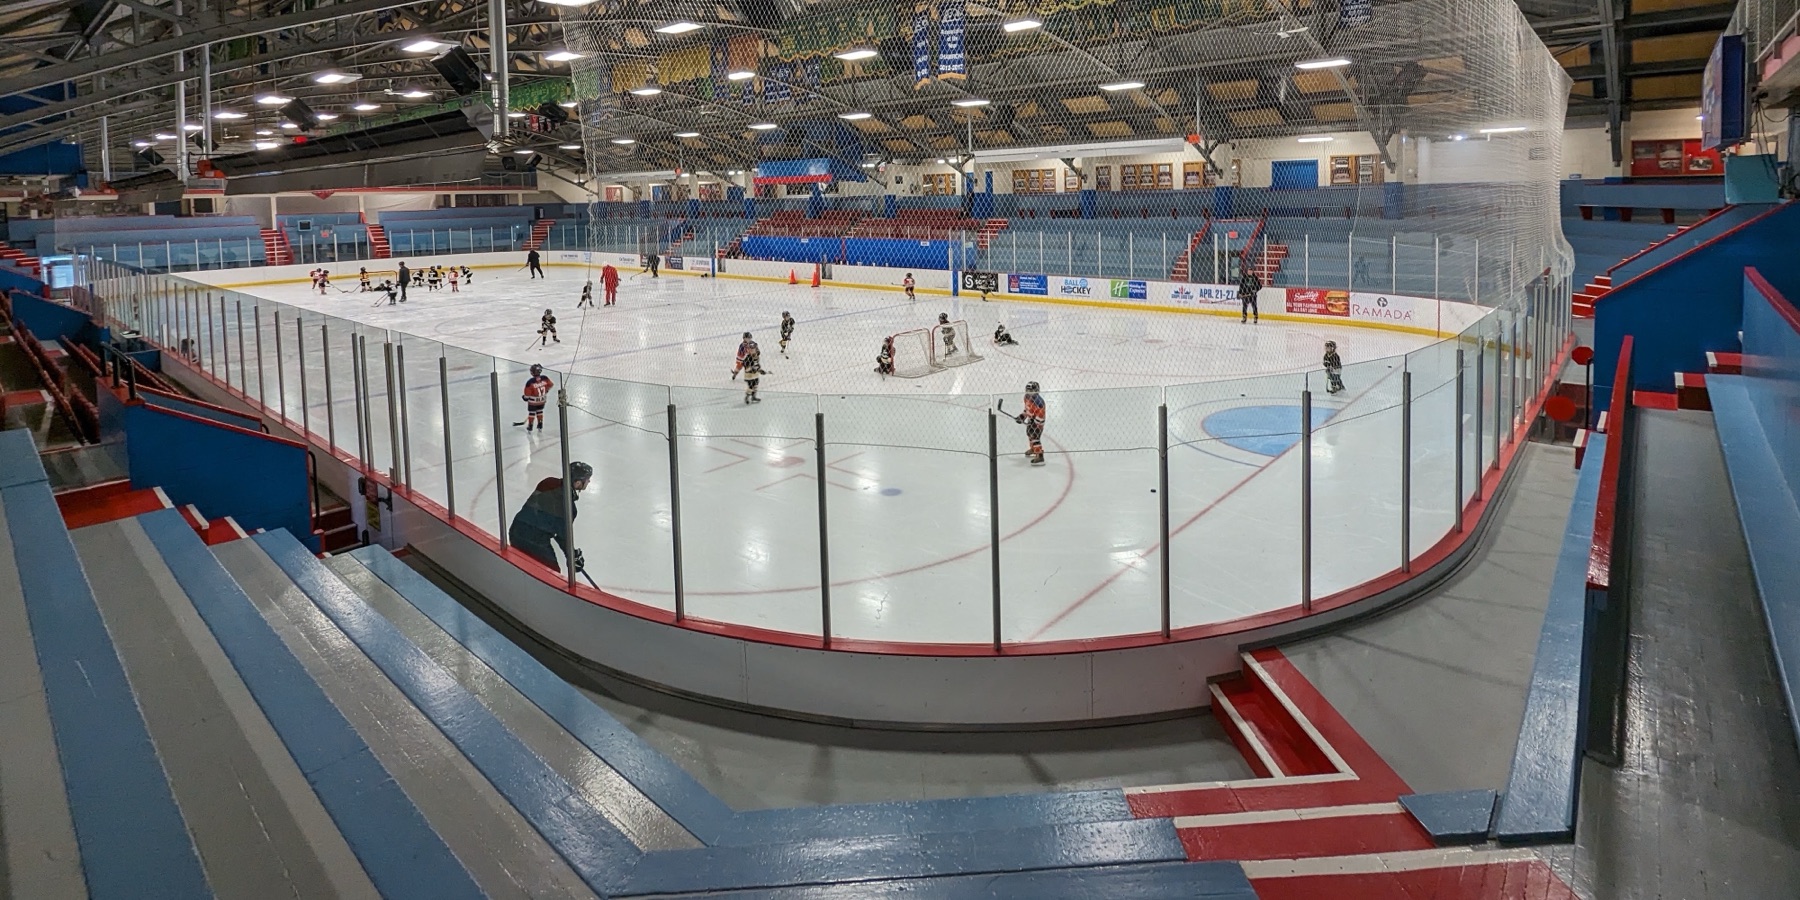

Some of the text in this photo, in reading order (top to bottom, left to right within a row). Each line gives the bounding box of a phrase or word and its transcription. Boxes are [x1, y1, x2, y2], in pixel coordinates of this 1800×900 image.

[1060, 285, 1091, 295] HOCKEY
[1199, 288, 1214, 299] APR.
[1352, 304, 1411, 320] RAMADA
